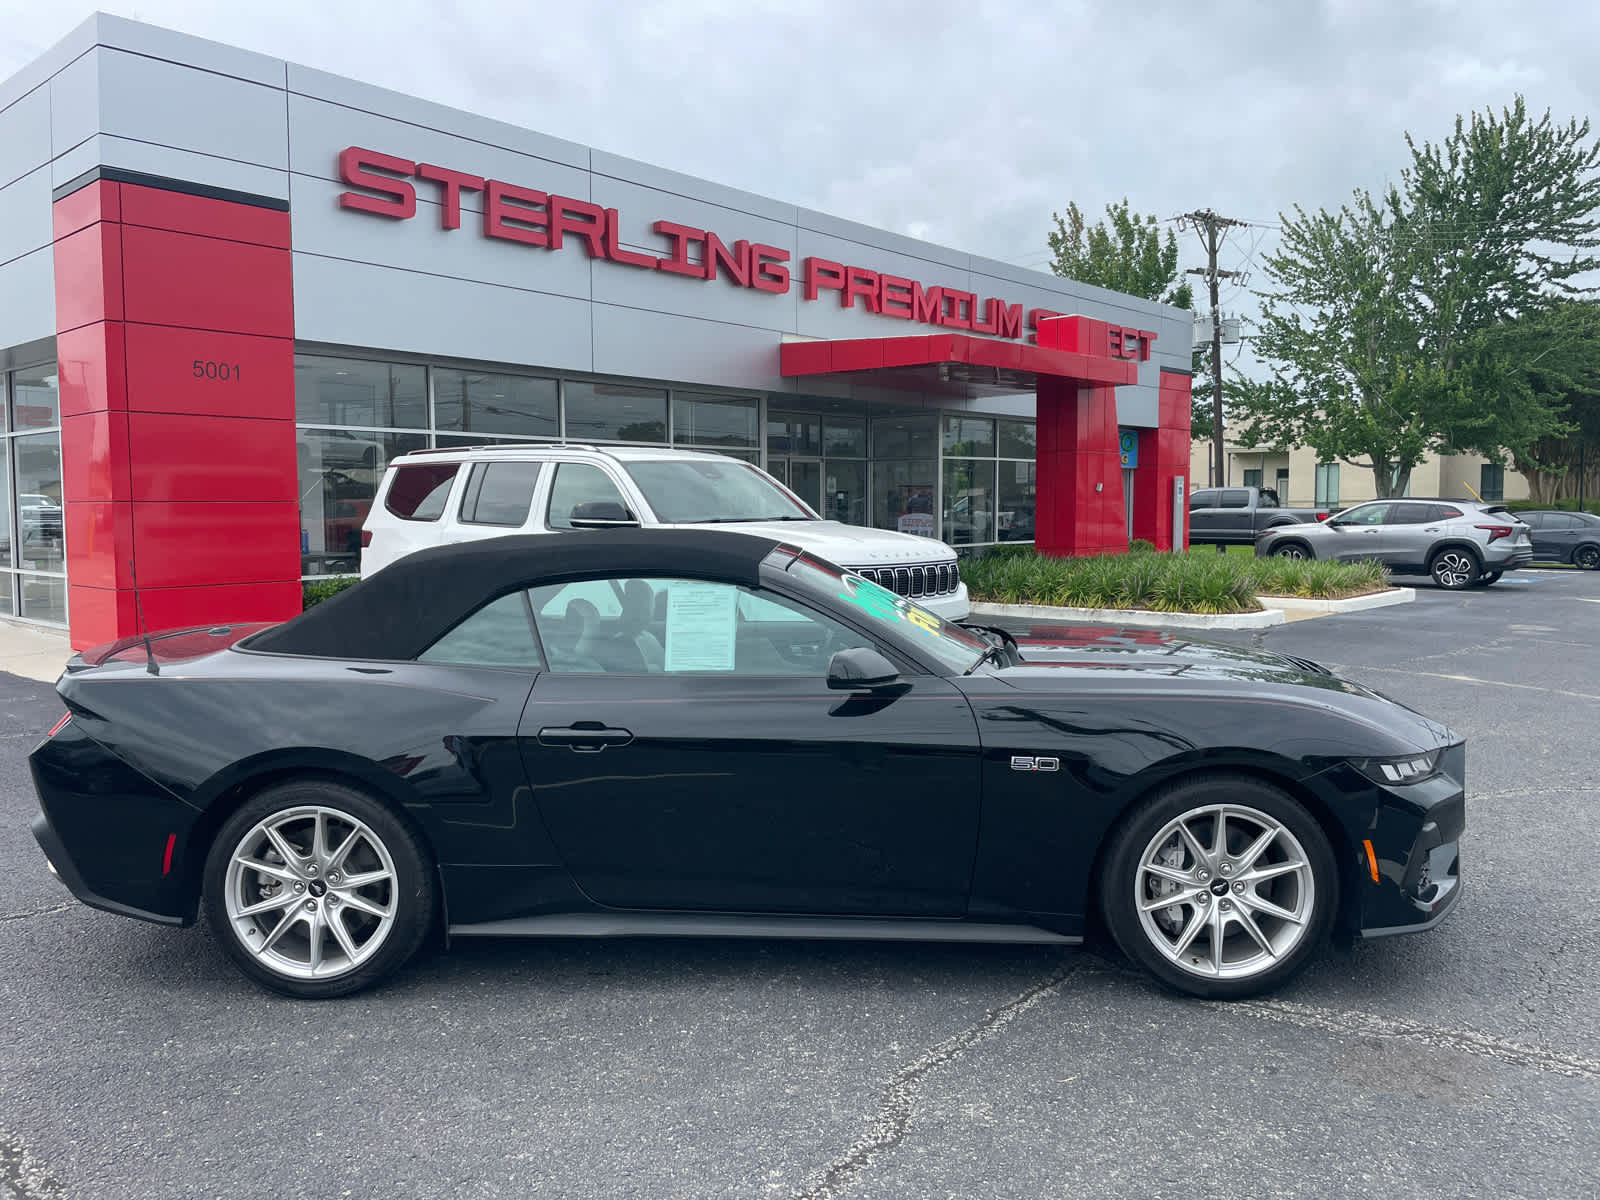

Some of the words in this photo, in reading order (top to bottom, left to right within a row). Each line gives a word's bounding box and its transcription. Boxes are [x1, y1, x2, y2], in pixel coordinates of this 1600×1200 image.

[339, 146, 791, 295] STERLING
[804, 256, 1023, 339] PREMIUM
[1028, 308, 1158, 362] SECT
[192, 360, 240, 381] 5001
[1010, 755, 1060, 772] 5.0
